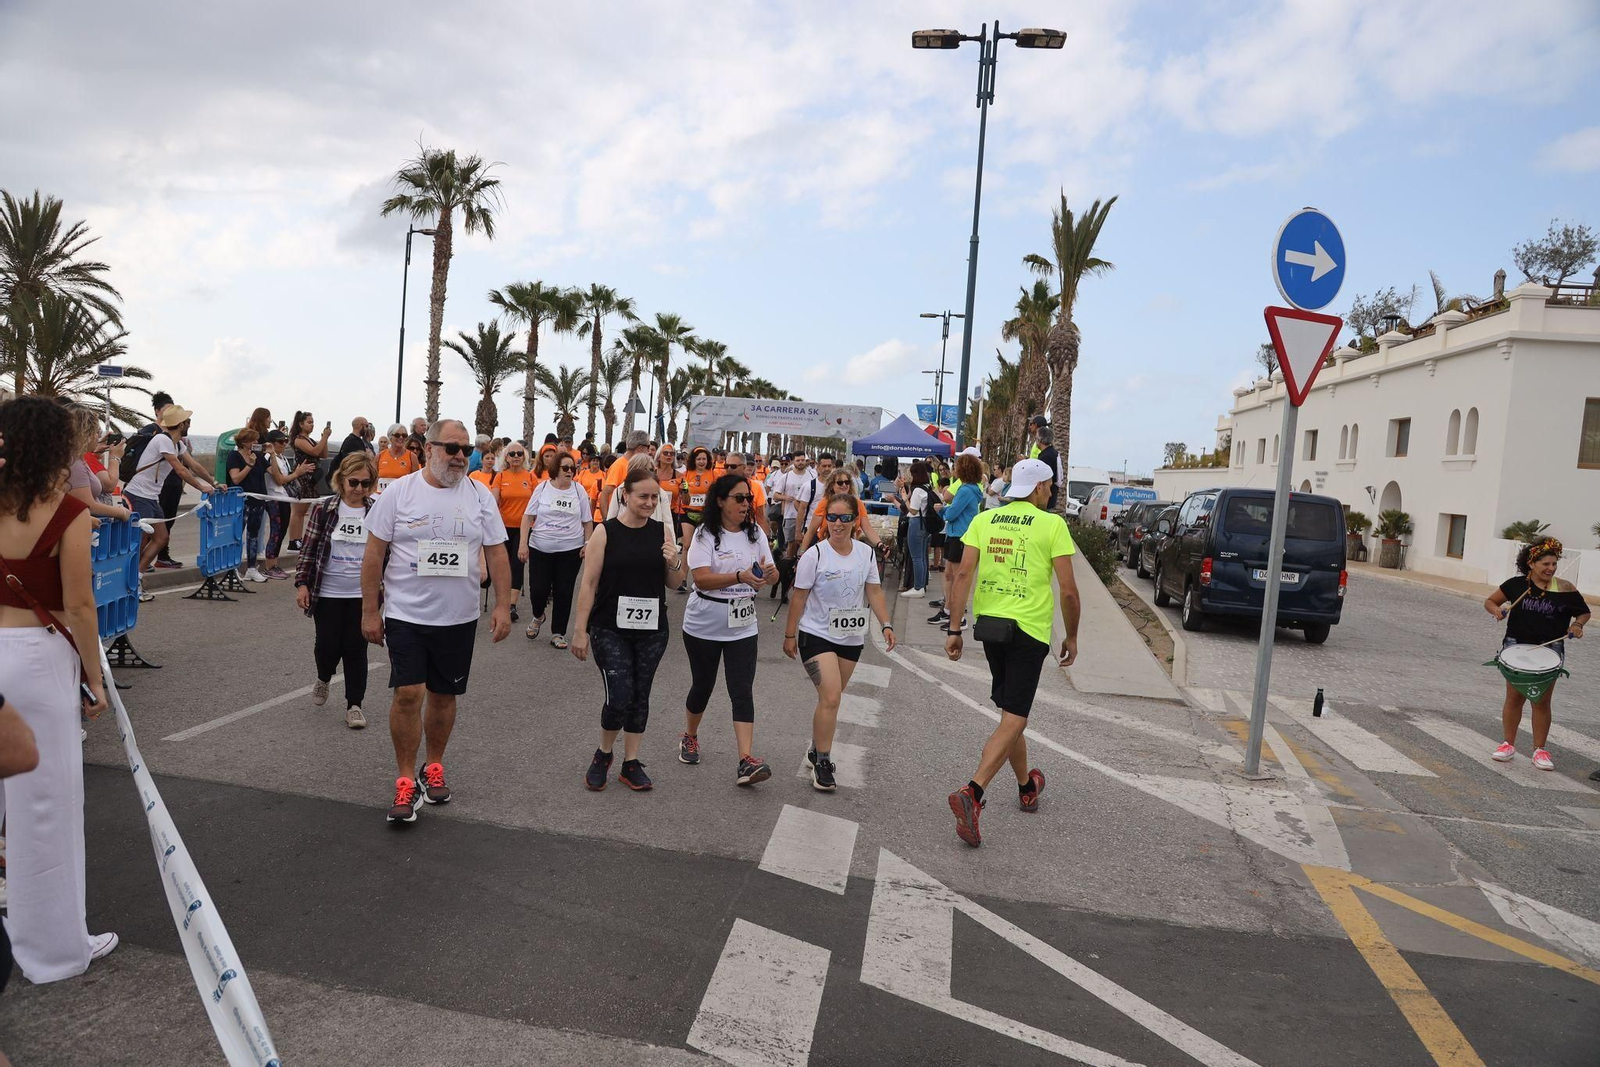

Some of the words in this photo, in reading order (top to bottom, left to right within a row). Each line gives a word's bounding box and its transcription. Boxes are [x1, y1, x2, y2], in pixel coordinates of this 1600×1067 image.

[764, 405, 806, 415] CARRERA
[871, 444, 932, 453] info@dorsalchip.es
[556, 499, 572, 508] 981
[990, 513, 1020, 525] CARRERA
[1020, 514, 1035, 526] 5K
[339, 523, 362, 535] 451
[427, 552, 459, 566] 452
[1281, 572, 1296, 581] HNR
[626, 608, 652, 620] 737
[832, 616, 866, 629] 1030
